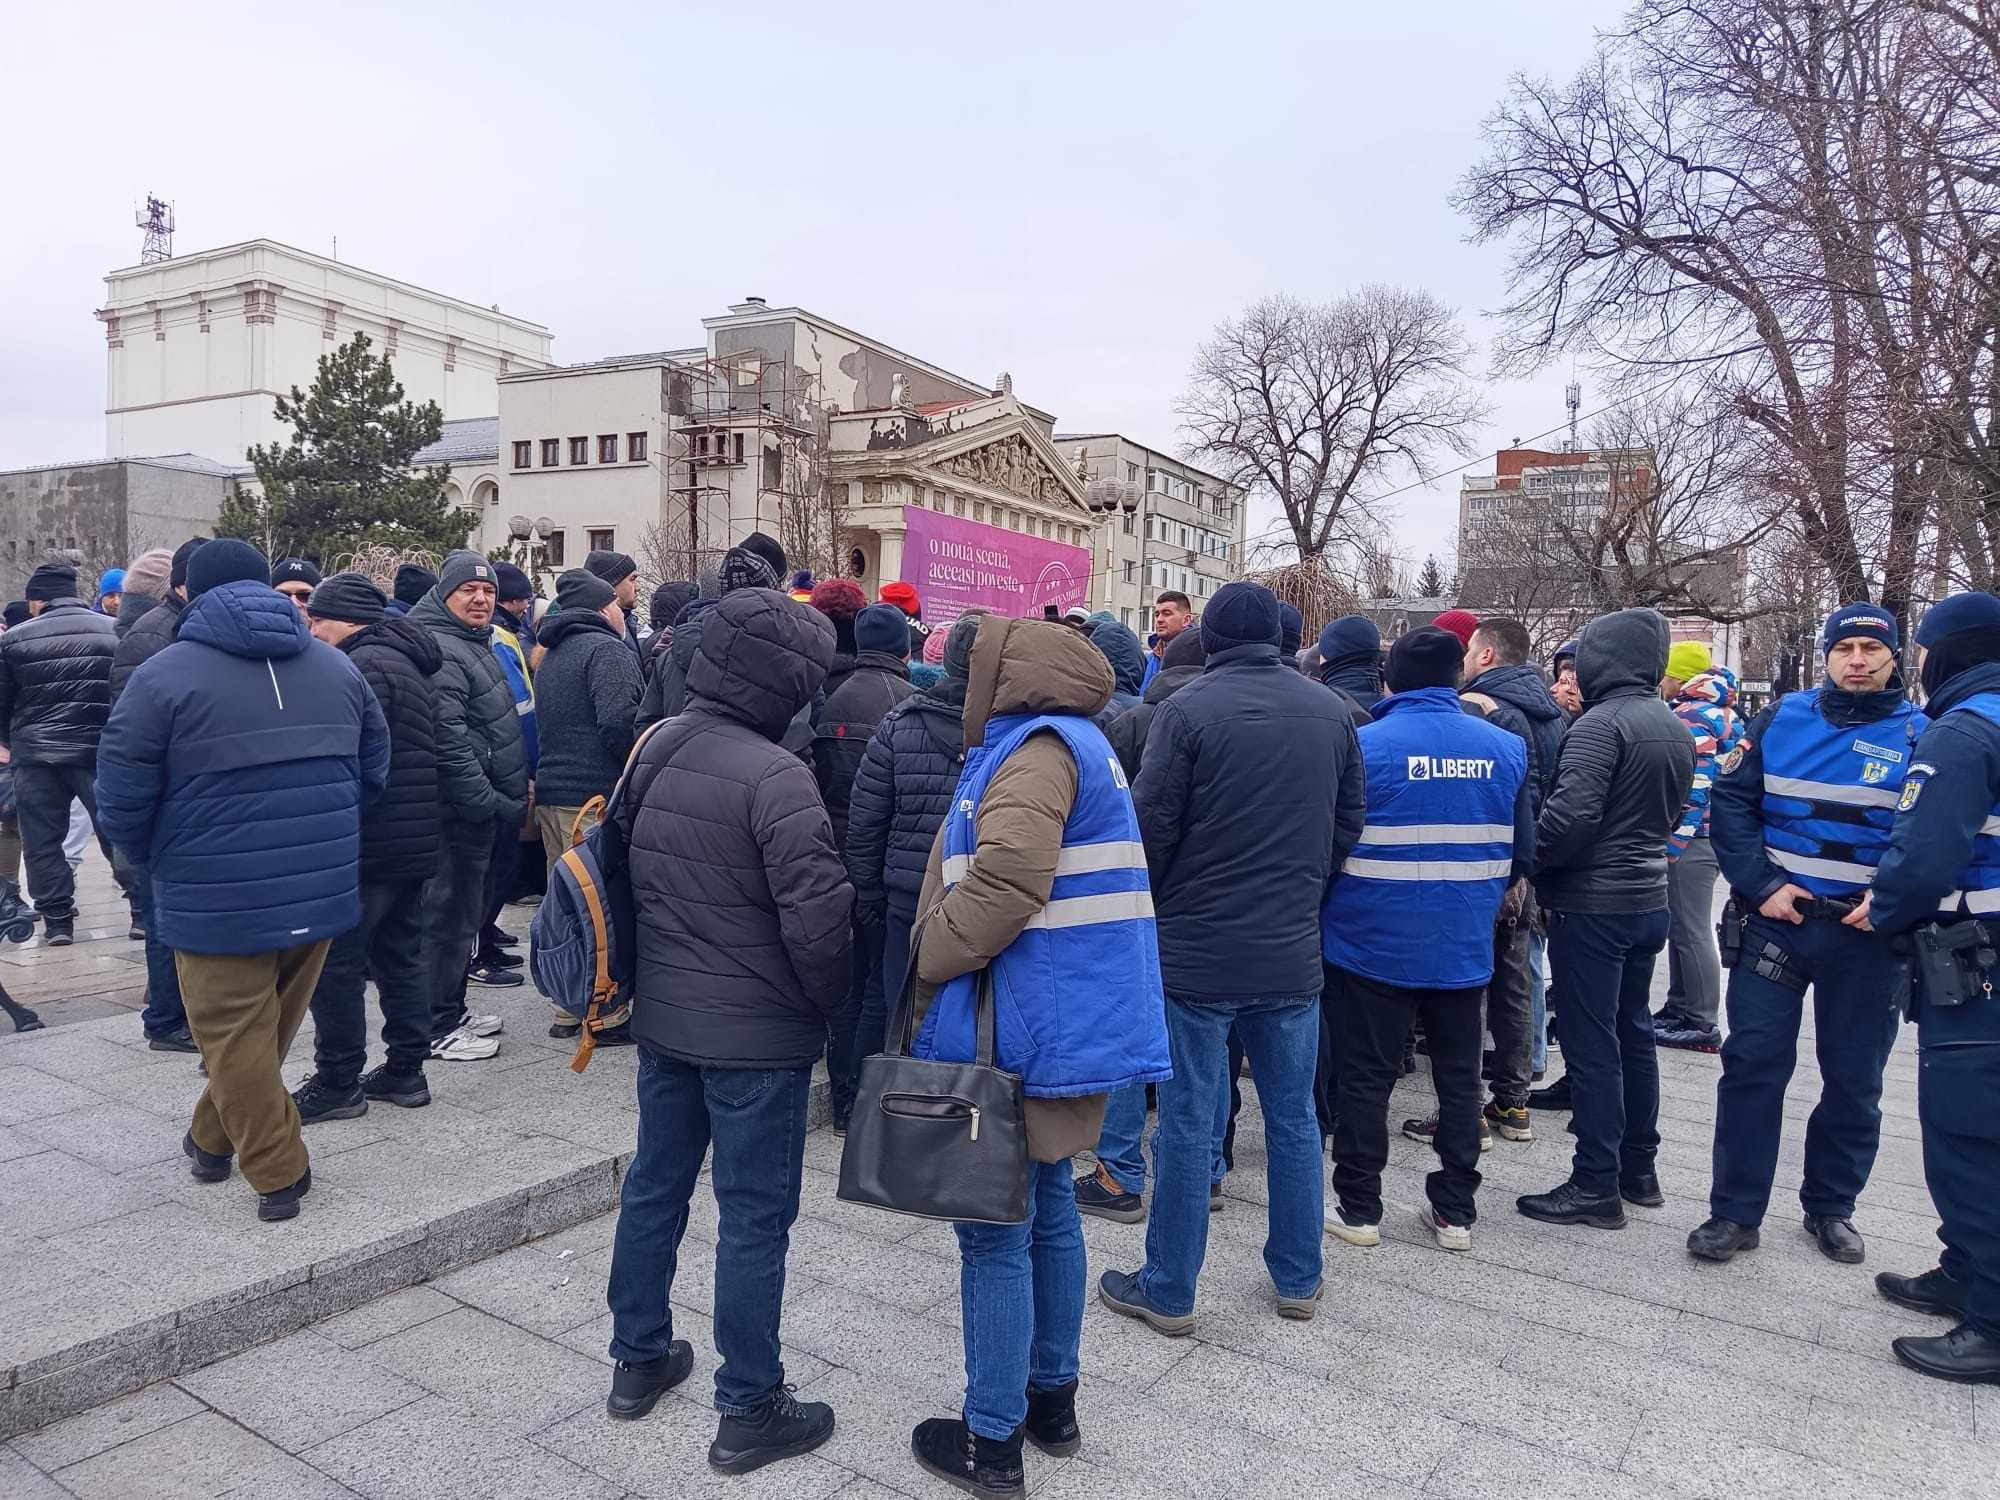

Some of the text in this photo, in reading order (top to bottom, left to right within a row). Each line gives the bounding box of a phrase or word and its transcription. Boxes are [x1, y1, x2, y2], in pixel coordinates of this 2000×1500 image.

[929, 538, 1011, 572] o nouă scenă,
[1839, 615, 1889, 628] JANDARMERIA
[1746, 683, 1766, 691] BUS
[1432, 758, 1494, 779] LIBERTY
